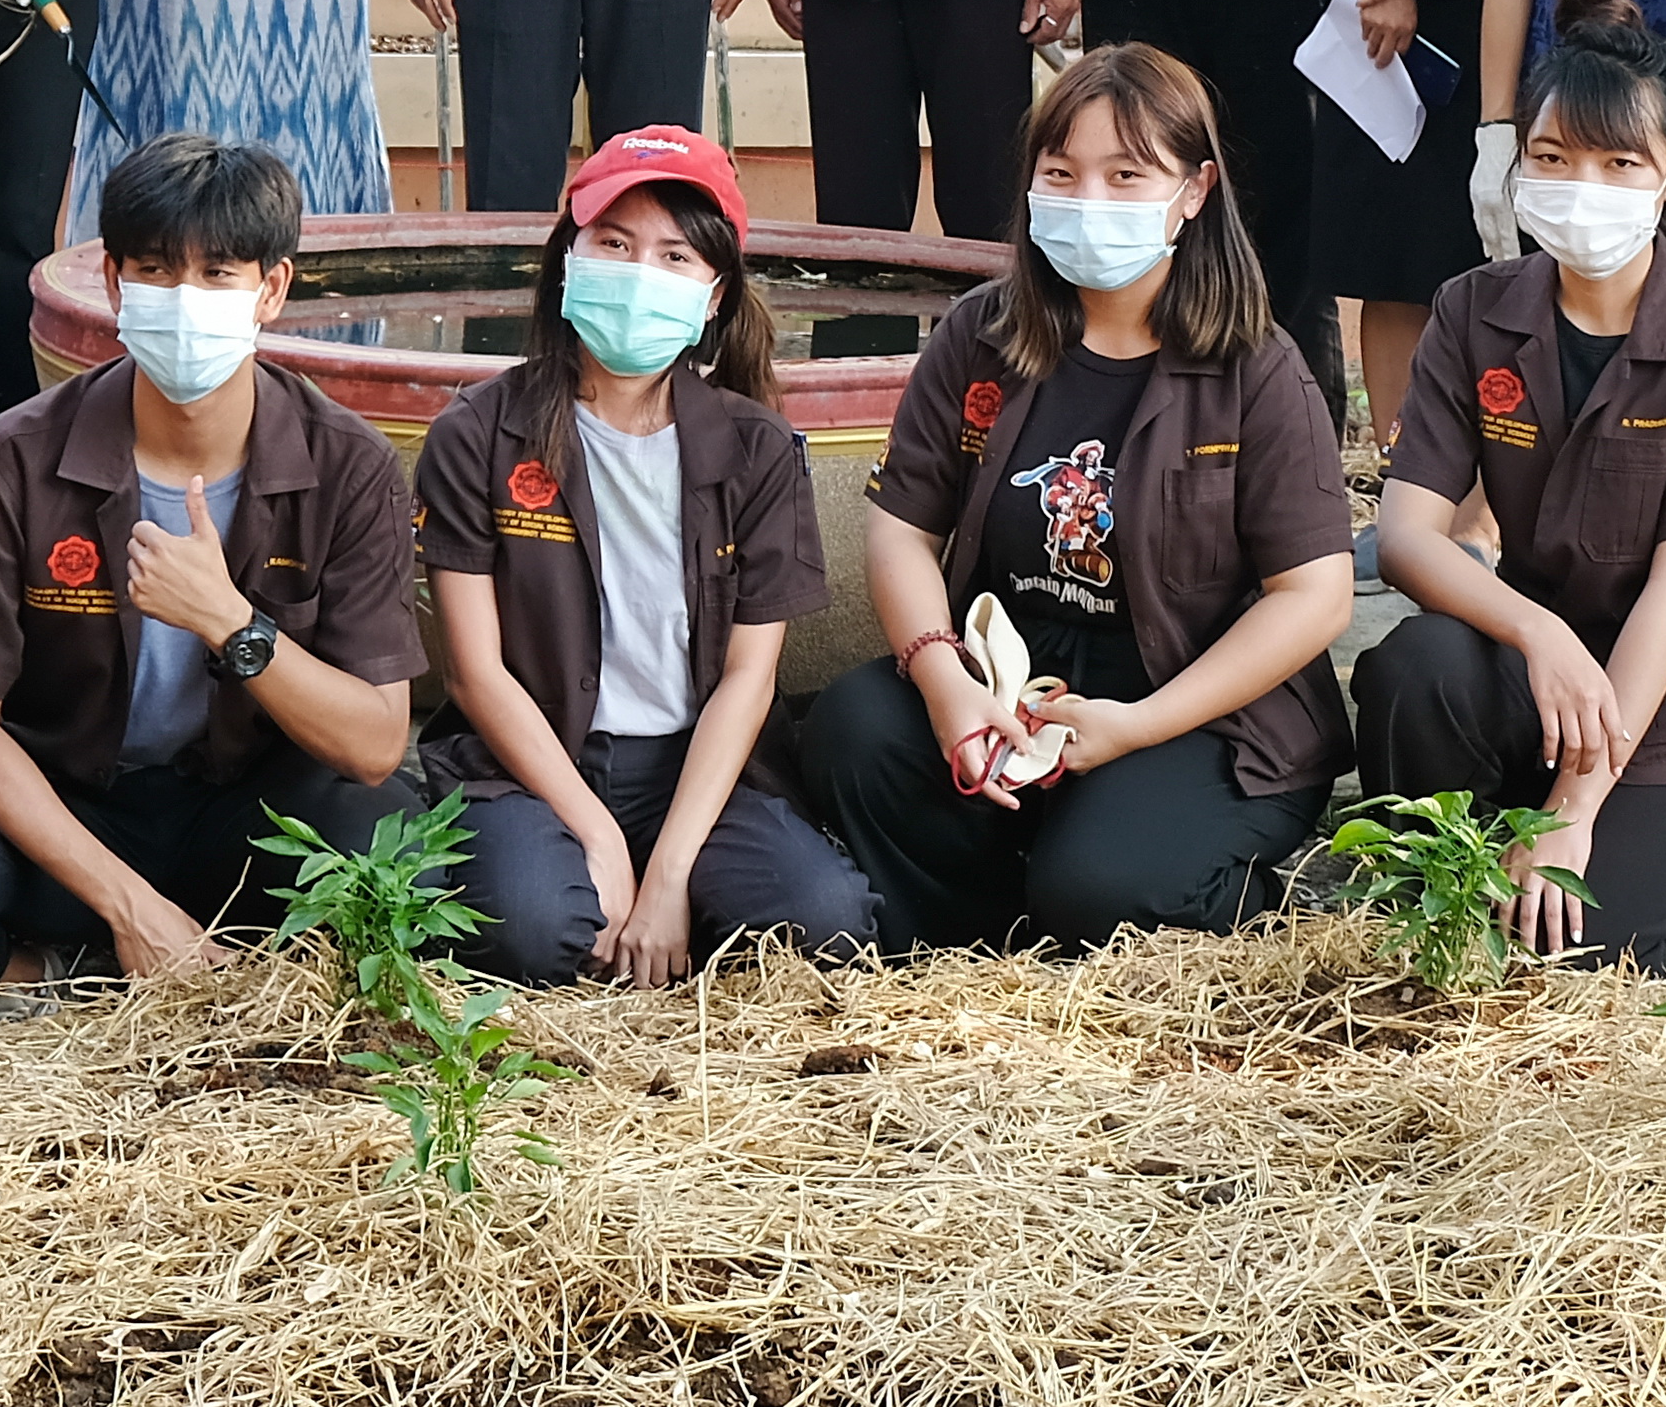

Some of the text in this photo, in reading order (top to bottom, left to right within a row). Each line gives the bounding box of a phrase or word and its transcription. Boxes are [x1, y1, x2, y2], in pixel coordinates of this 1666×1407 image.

[621, 137, 690, 154] Reebok
[1009, 572, 1116, 614] Captain Morgan
